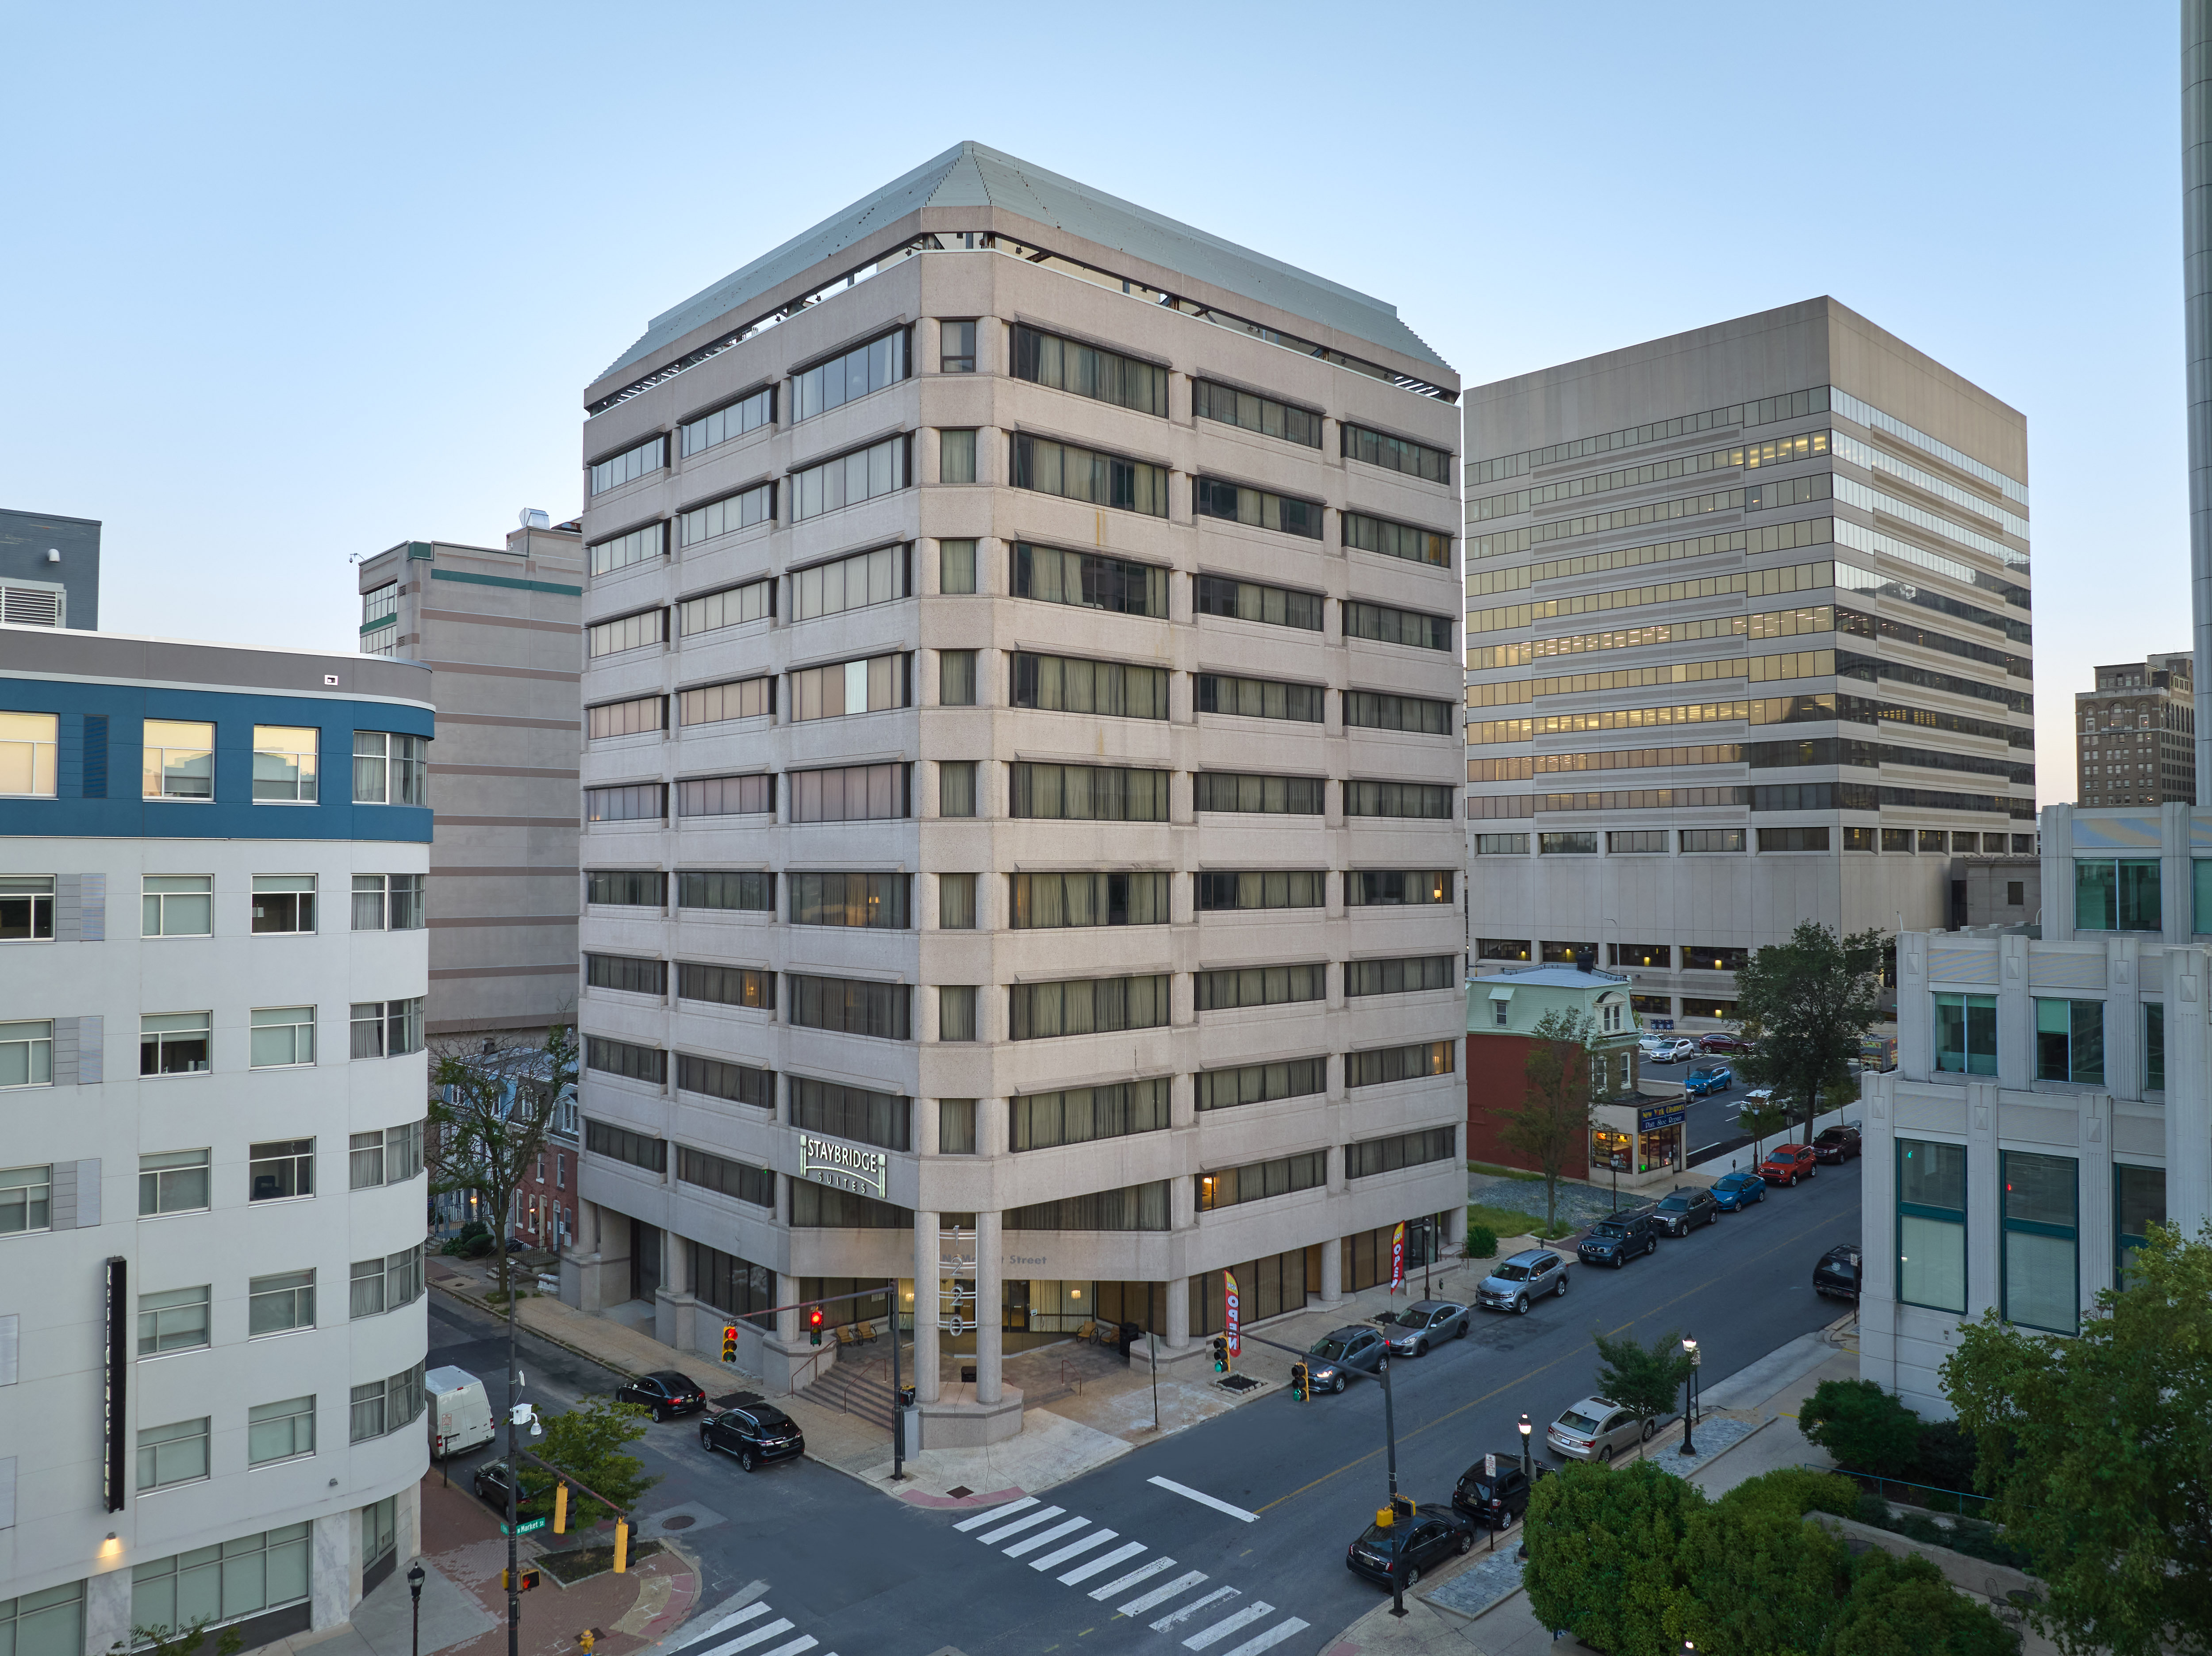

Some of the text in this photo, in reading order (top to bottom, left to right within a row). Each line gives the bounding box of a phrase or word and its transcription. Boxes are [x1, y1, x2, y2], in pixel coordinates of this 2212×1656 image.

[1666, 1104, 1684, 1114] Cleaners
[808, 1139, 878, 1173] STAYBRIDGE
[818, 1171, 867, 1194] SUITES
[1010, 1254, 1047, 1265] Street
[949, 1225, 964, 1337] 1220
[521, 1521, 538, 1533] Market
